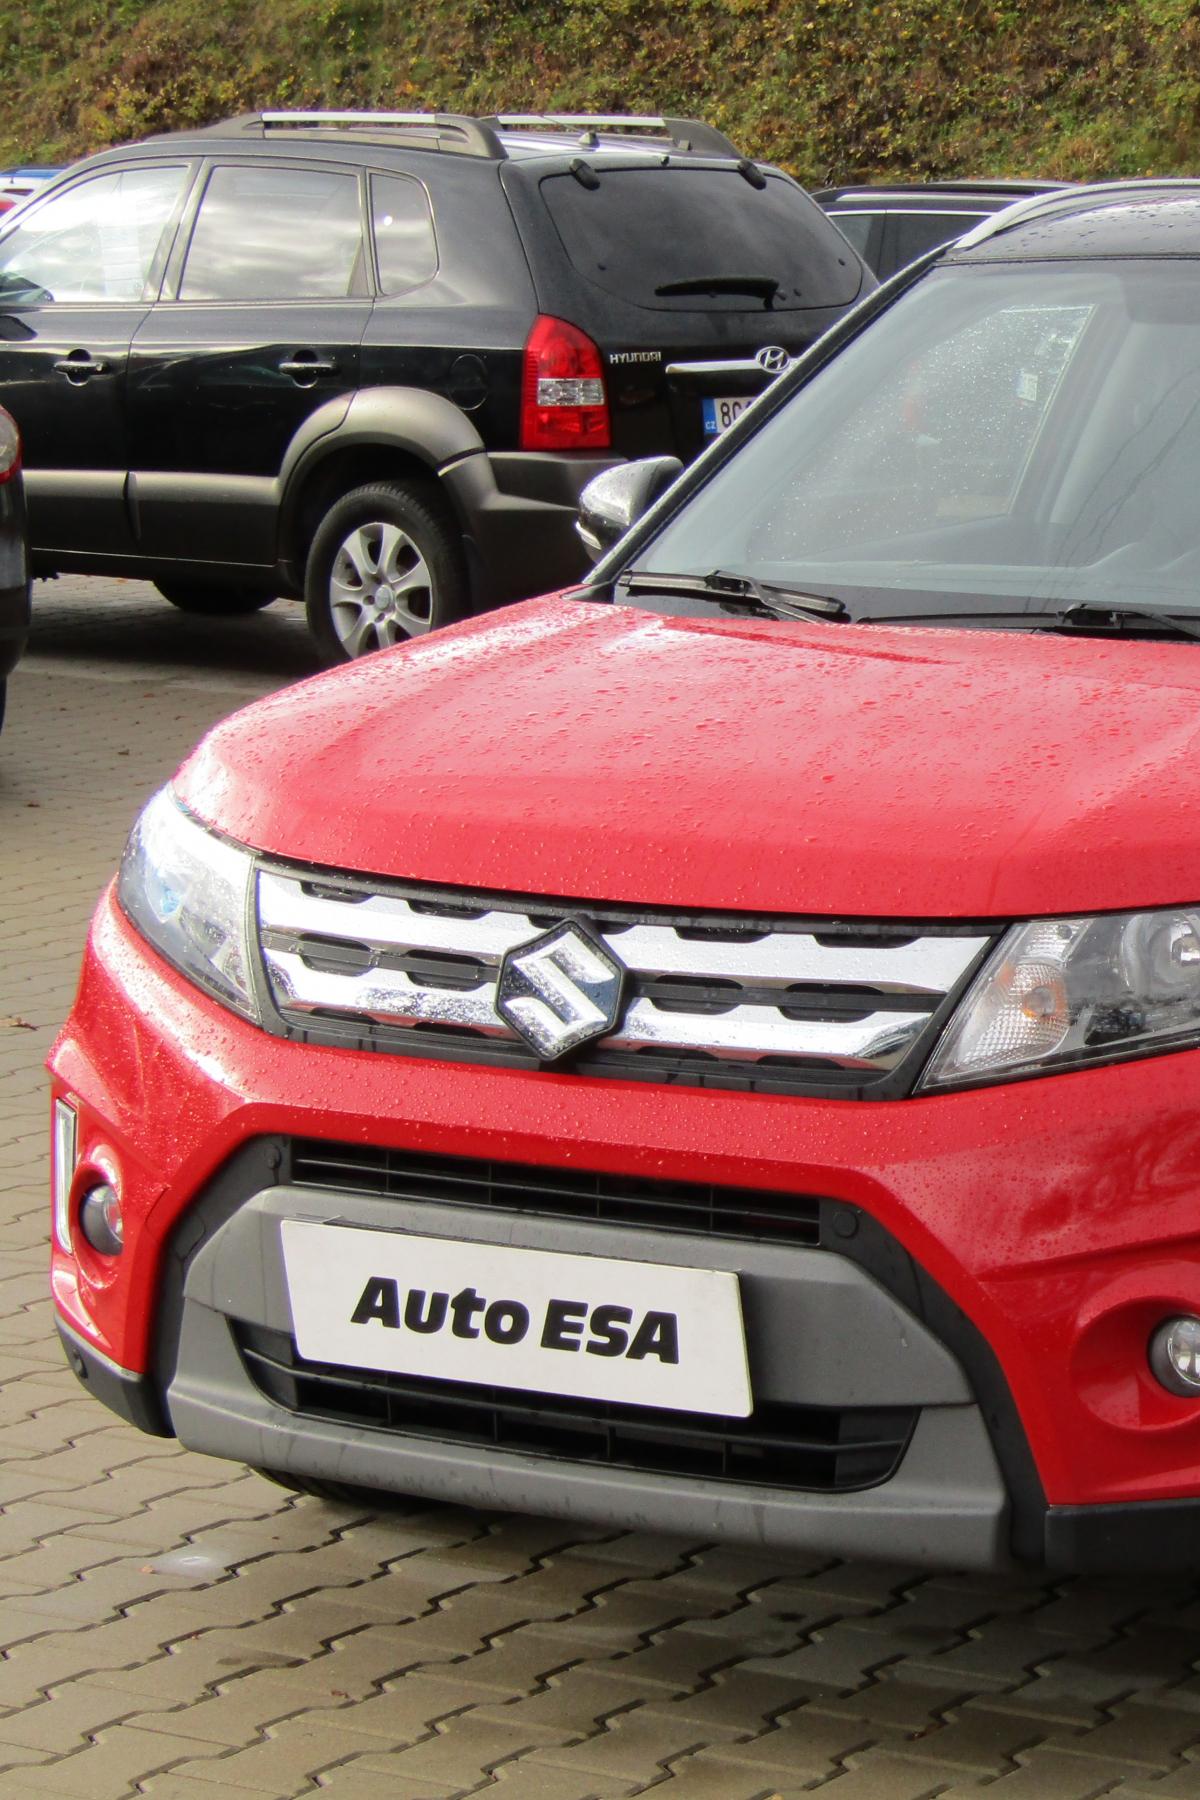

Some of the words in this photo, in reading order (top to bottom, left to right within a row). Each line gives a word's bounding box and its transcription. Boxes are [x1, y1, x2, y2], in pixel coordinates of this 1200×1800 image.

[609, 351, 662, 364] HYUNDAI
[705, 421, 717, 430] CZ
[350, 1276, 530, 1345] Auto
[540, 1298, 679, 1365] ESA
